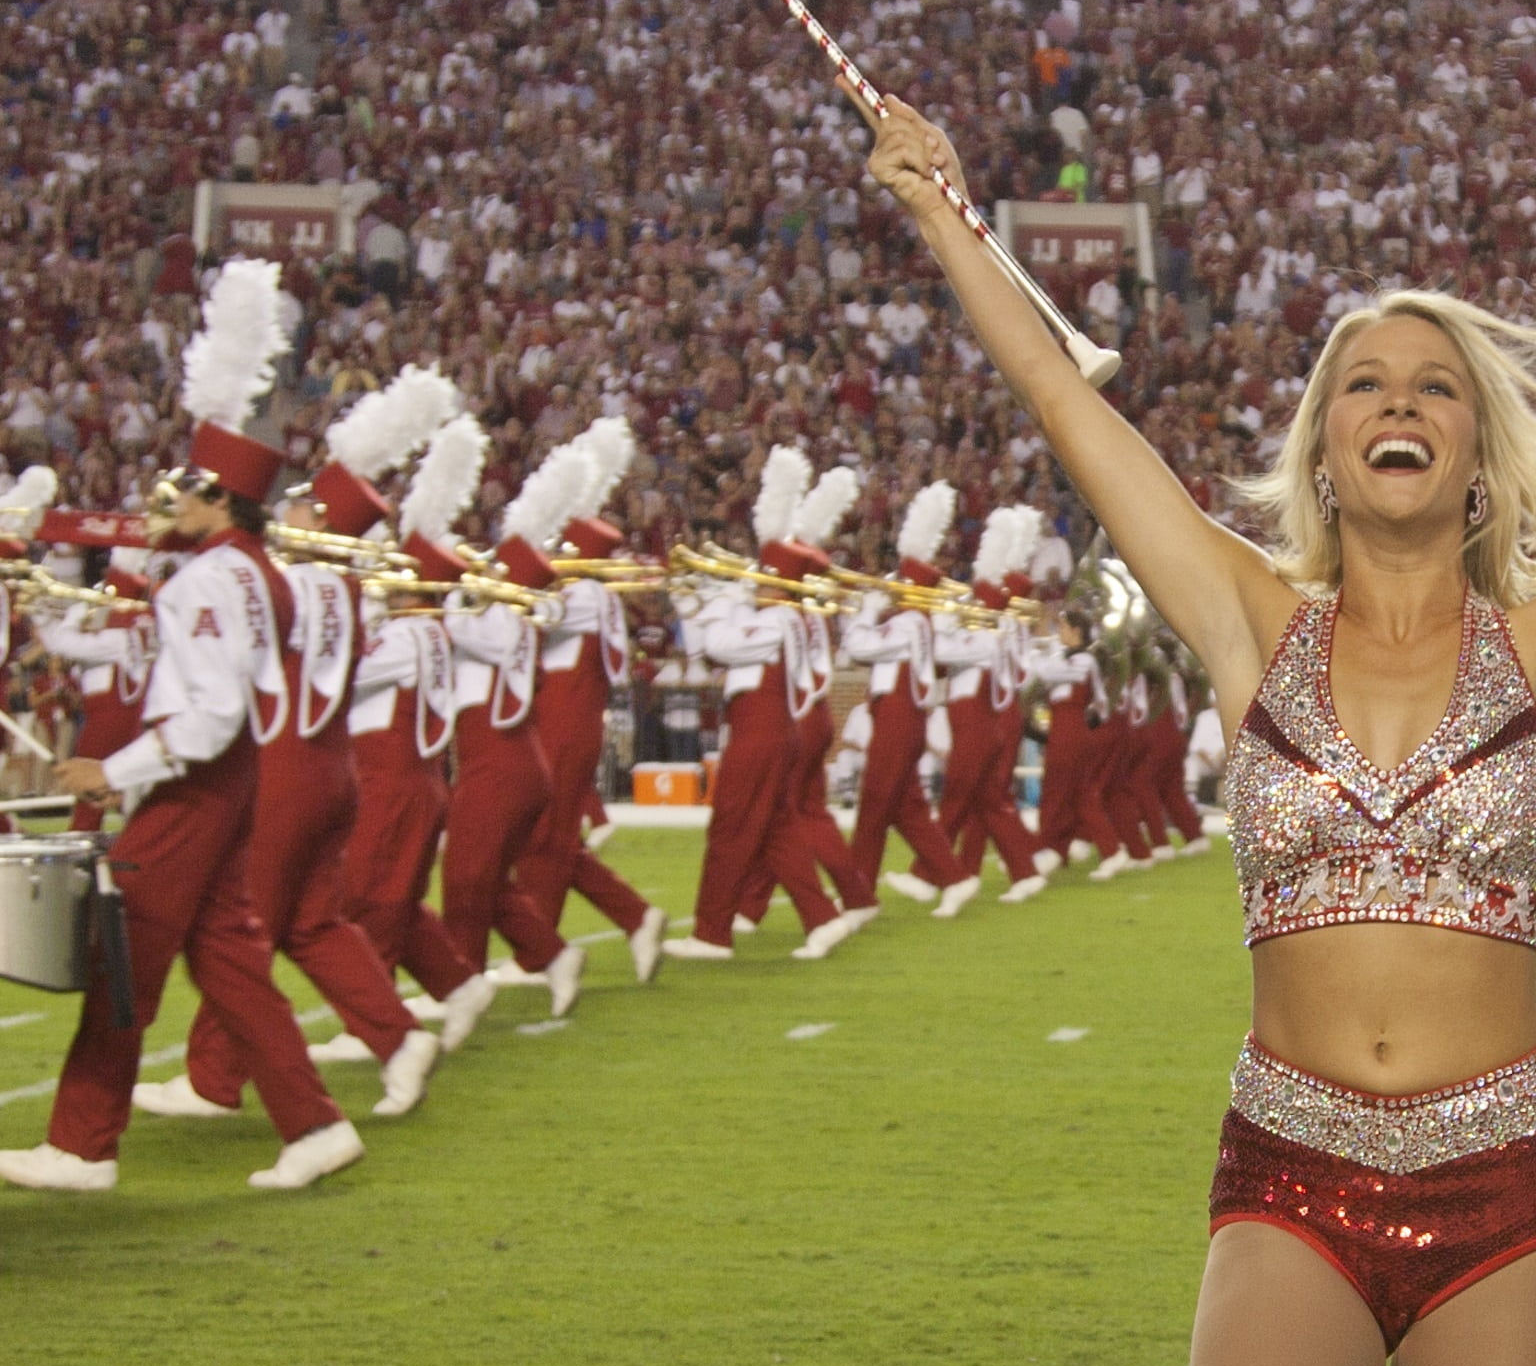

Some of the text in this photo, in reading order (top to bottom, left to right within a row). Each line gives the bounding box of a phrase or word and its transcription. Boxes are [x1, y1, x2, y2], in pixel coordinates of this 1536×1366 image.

[290, 221, 324, 245] JJ
[1029, 238, 1060, 262] JJ
[192, 606, 221, 638] A
[231, 567, 267, 650] BAMA
[318, 584, 338, 657] BAMA
[425, 625, 446, 691] BAMA
